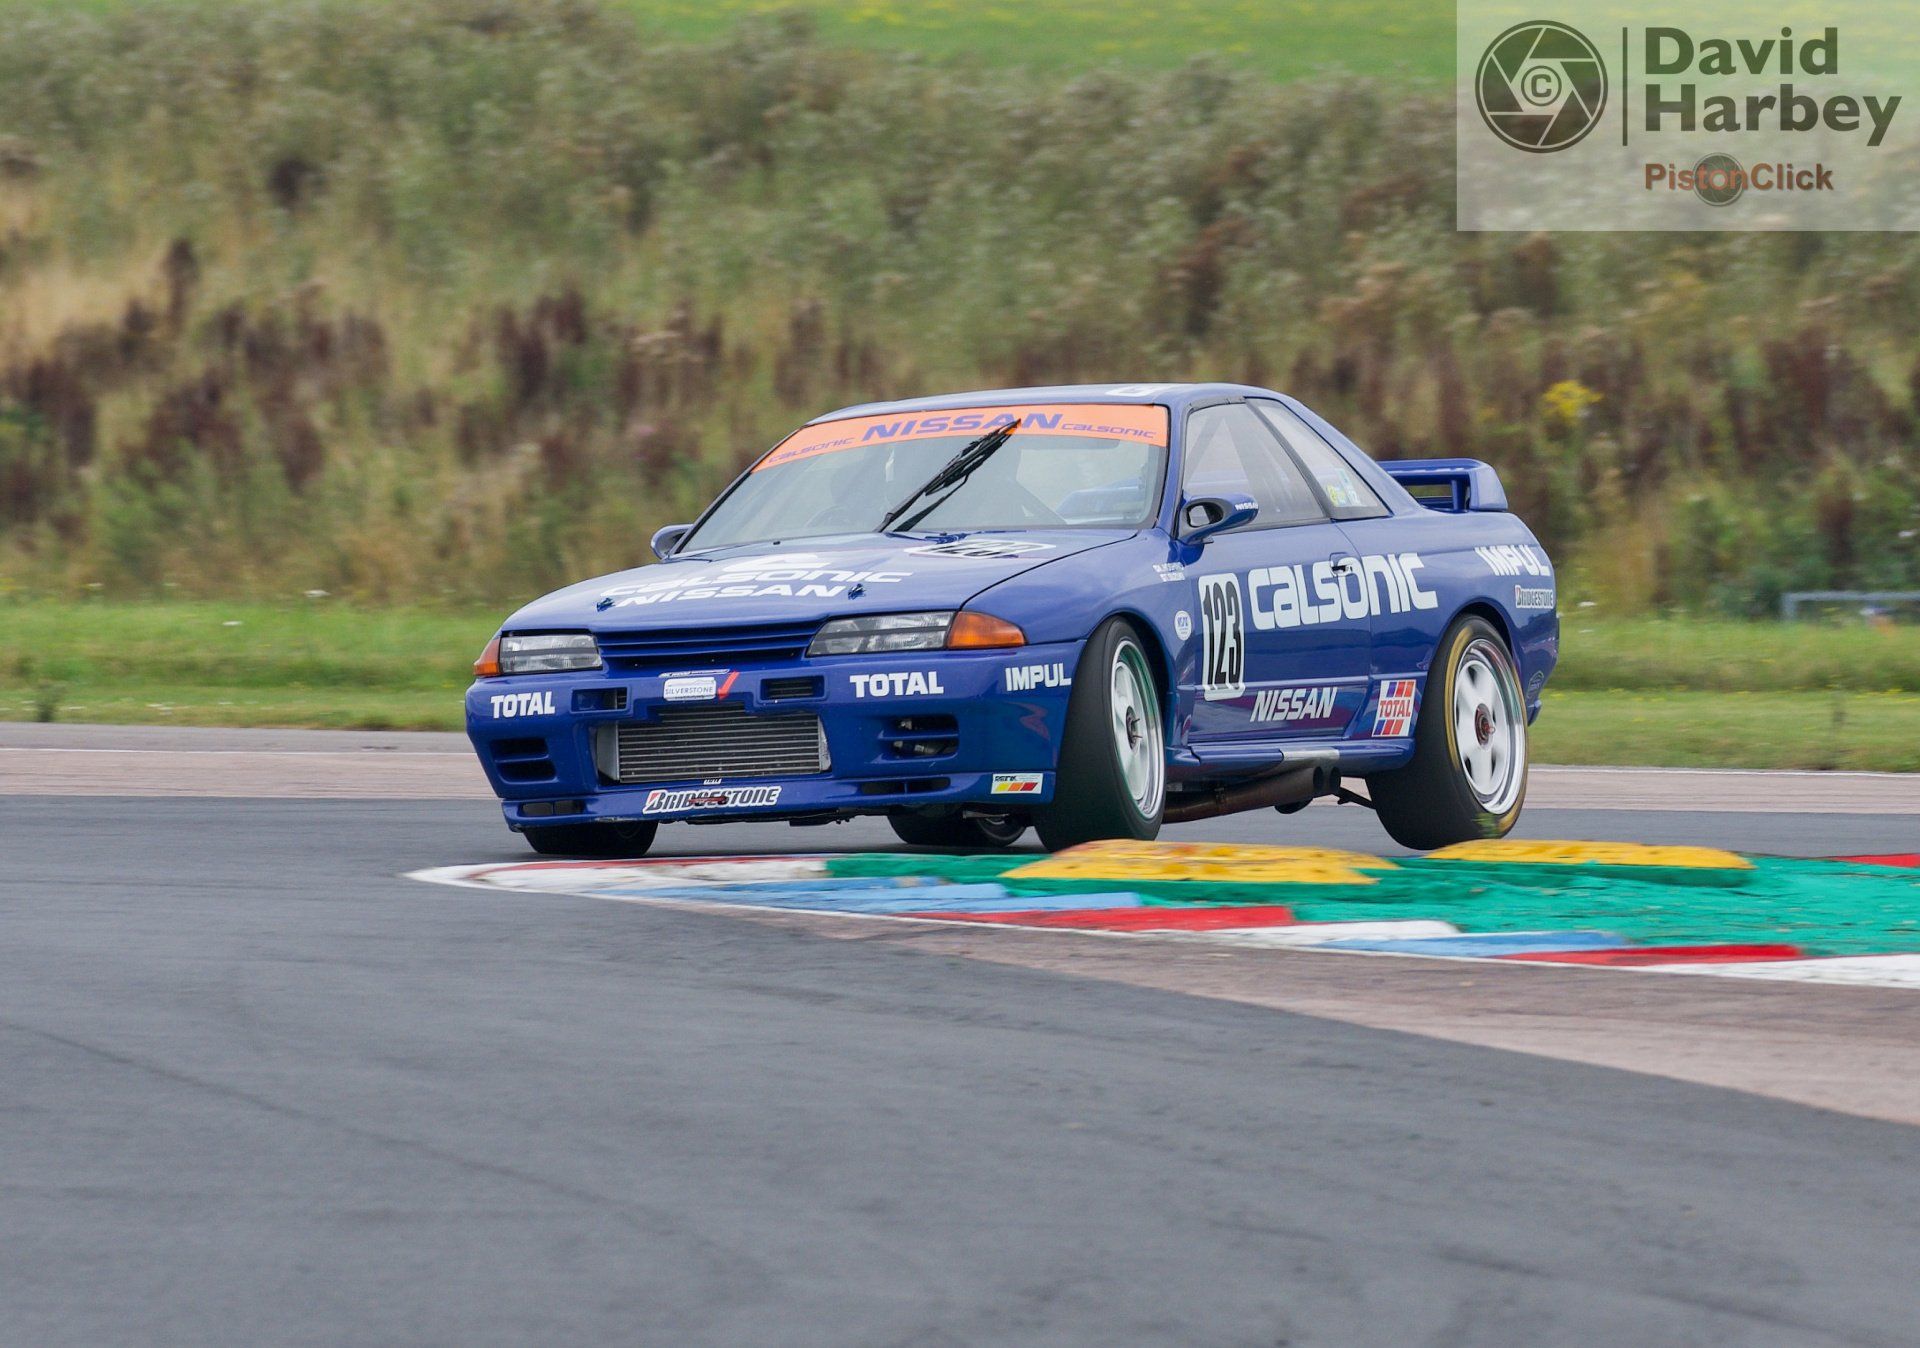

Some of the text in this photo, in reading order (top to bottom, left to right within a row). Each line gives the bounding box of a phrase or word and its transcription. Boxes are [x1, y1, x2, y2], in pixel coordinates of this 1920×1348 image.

[861, 413, 1063, 442] NISSAN
[1474, 544, 1551, 577] IMPUL
[615, 584, 846, 608] NISSAN
[1202, 580, 1242, 685] 123
[665, 686, 713, 695] SILVERSTONE
[850, 671, 944, 698] TOTAL
[1005, 663, 1072, 692] IMPUL
[490, 691, 556, 719] TOTAL
[1250, 687, 1337, 722] NISSAN
[1379, 697, 1411, 718] TOTAL
[643, 786, 781, 813] BRIDGESTONE
